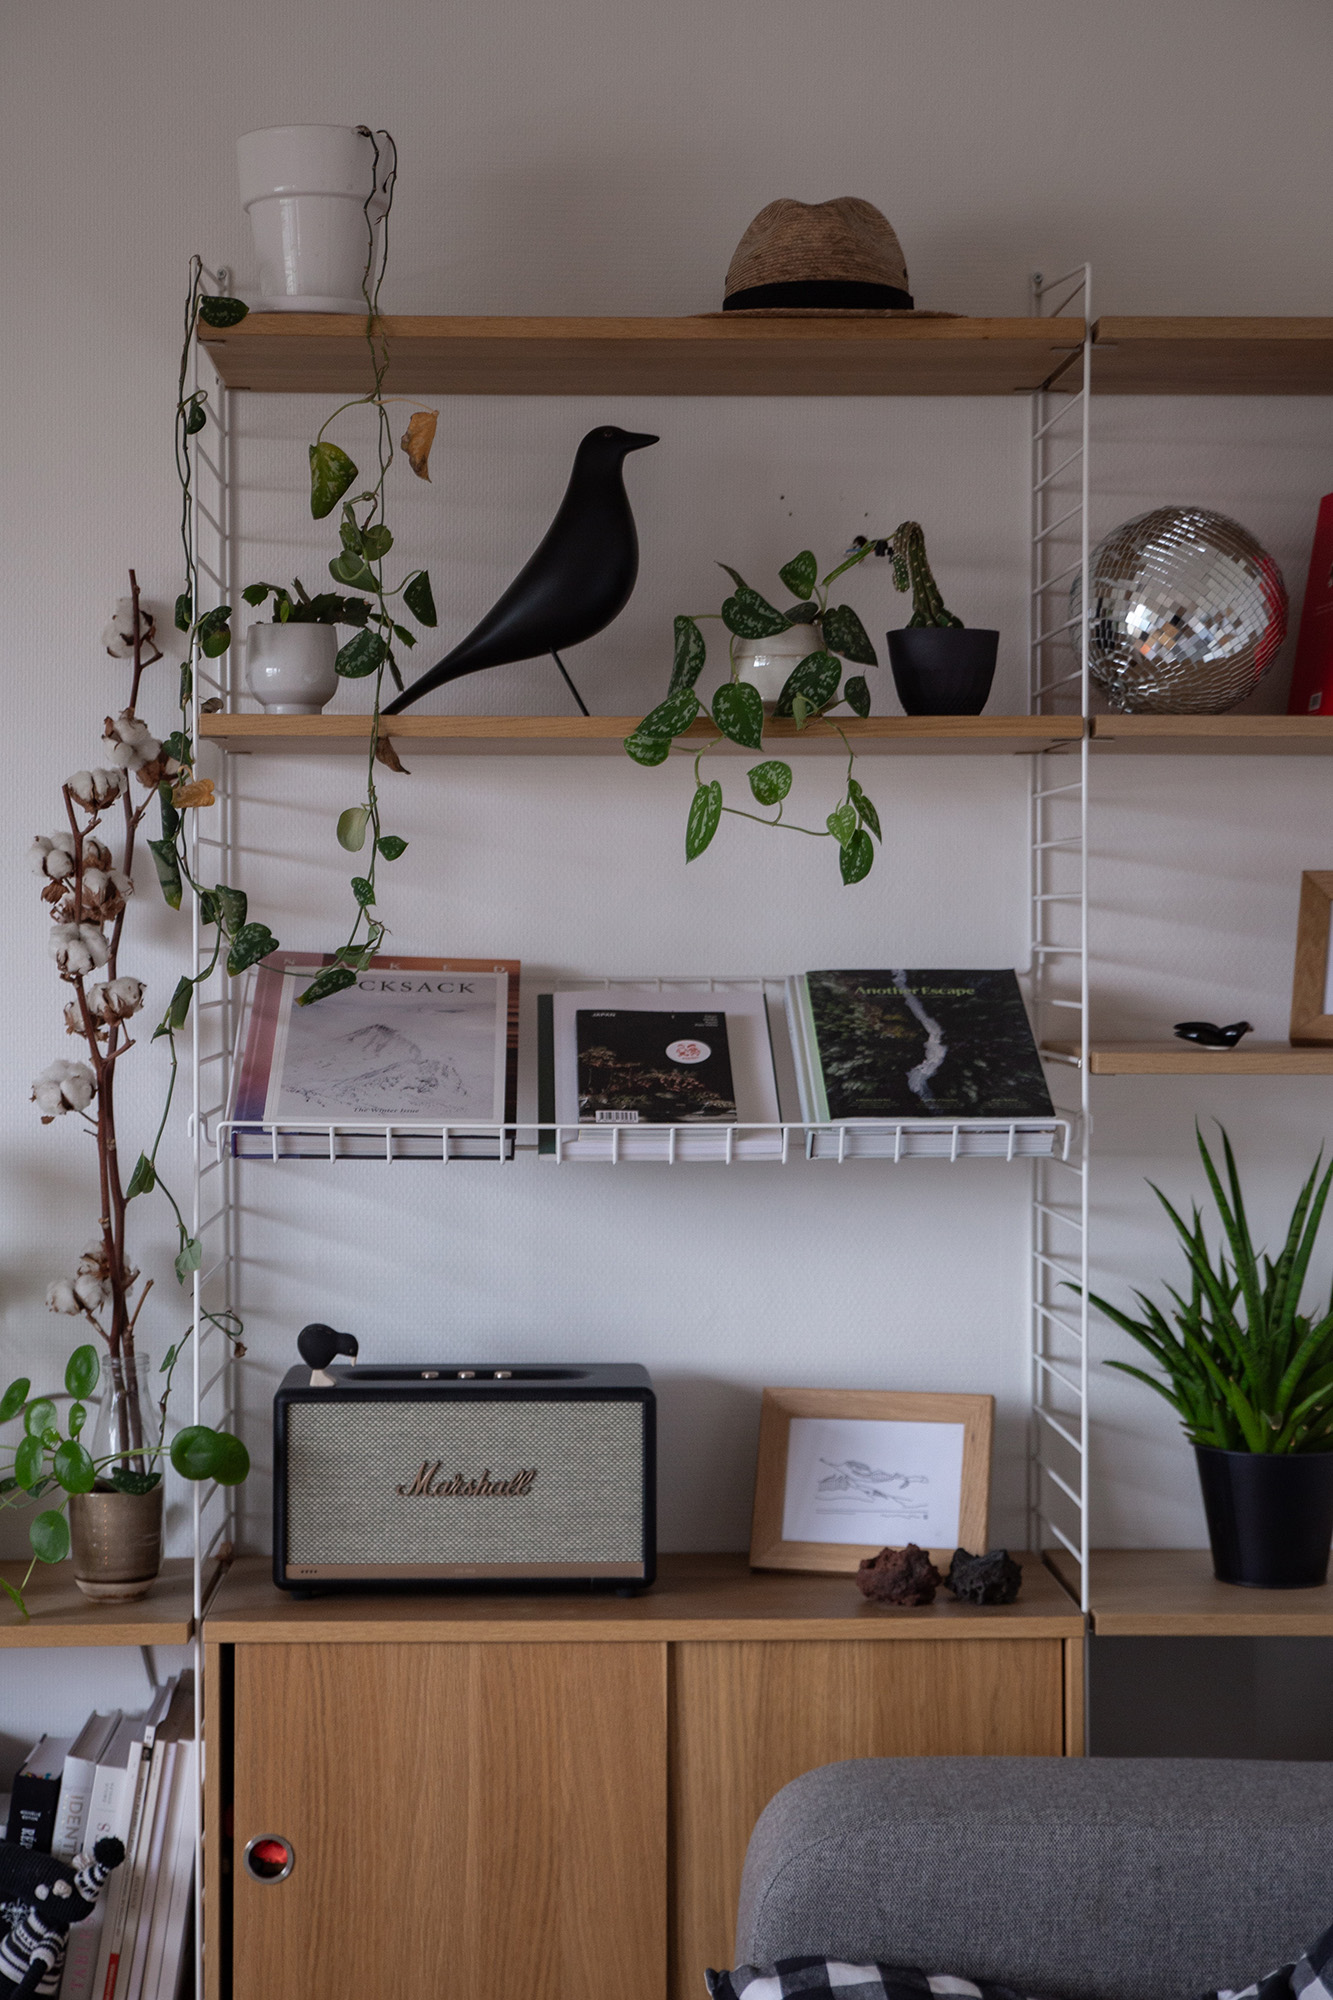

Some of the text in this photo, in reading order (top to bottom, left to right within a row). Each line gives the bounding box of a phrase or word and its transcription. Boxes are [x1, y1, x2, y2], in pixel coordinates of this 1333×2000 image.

[348, 979, 476, 995] CKSACK
[855, 986, 976, 997] Another Escape
[396, 1460, 536, 1498] Marshall
[62, 1795, 84, 1857] IDENTI
[20, 1827, 37, 1849] RÉP
